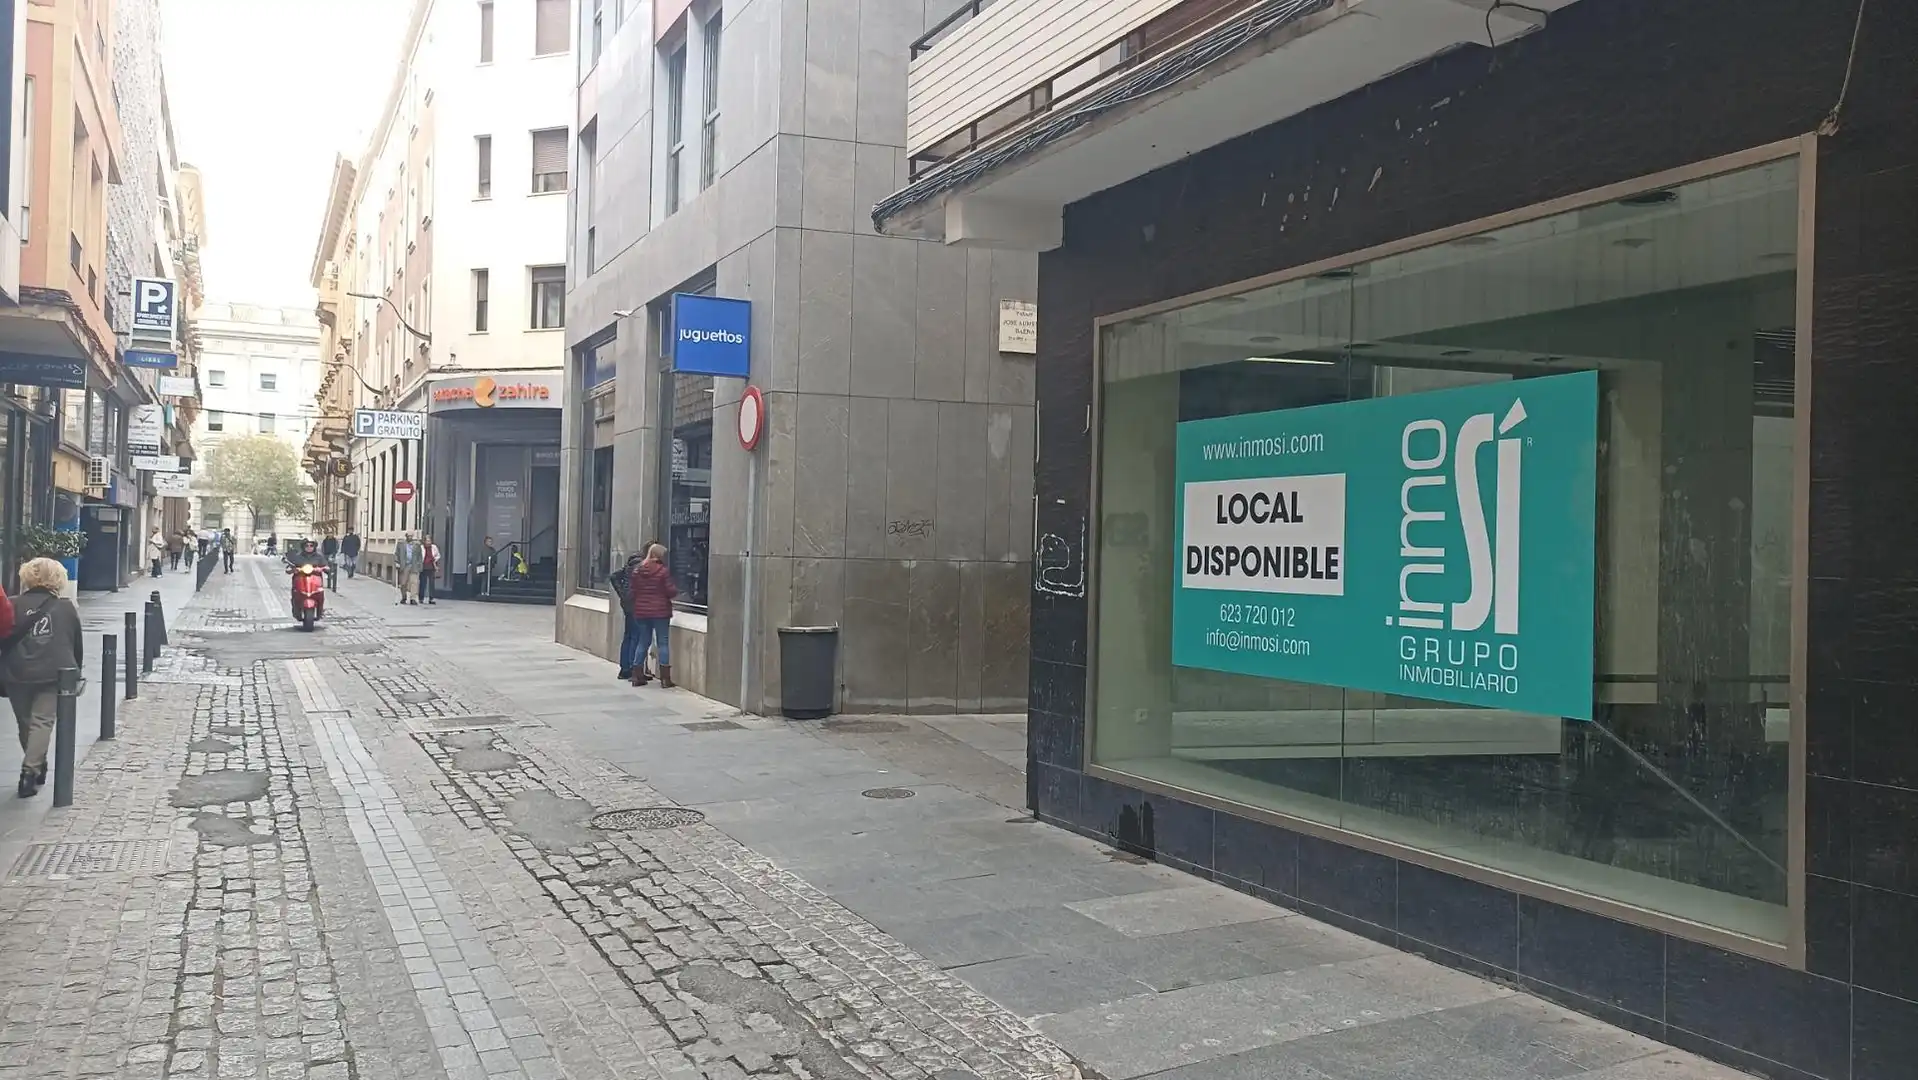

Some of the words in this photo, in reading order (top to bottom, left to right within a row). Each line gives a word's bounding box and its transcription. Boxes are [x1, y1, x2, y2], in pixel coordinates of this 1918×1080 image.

[140, 282, 167, 312] P
[679, 328, 743, 344] juguettos
[498, 383, 549, 400] zahira
[377, 412, 420, 426] PARKING
[377, 426, 420, 438] GRATUITO
[1203, 432, 1324, 461] www.inmosi.com
[1216, 491, 1304, 525] LOCAL
[1386, 418, 1447, 630] inmo
[1186, 545, 1339, 580] DISPONIBLE
[1220, 603, 1242, 624] 623
[1245, 605, 1268, 625] 720
[1271, 607, 1295, 627] 012
[1206, 628, 1311, 656] info@inmosi.com
[1400, 636, 1519, 671] GRUPO
[1399, 664, 1519, 694] INMOBILIARIO
